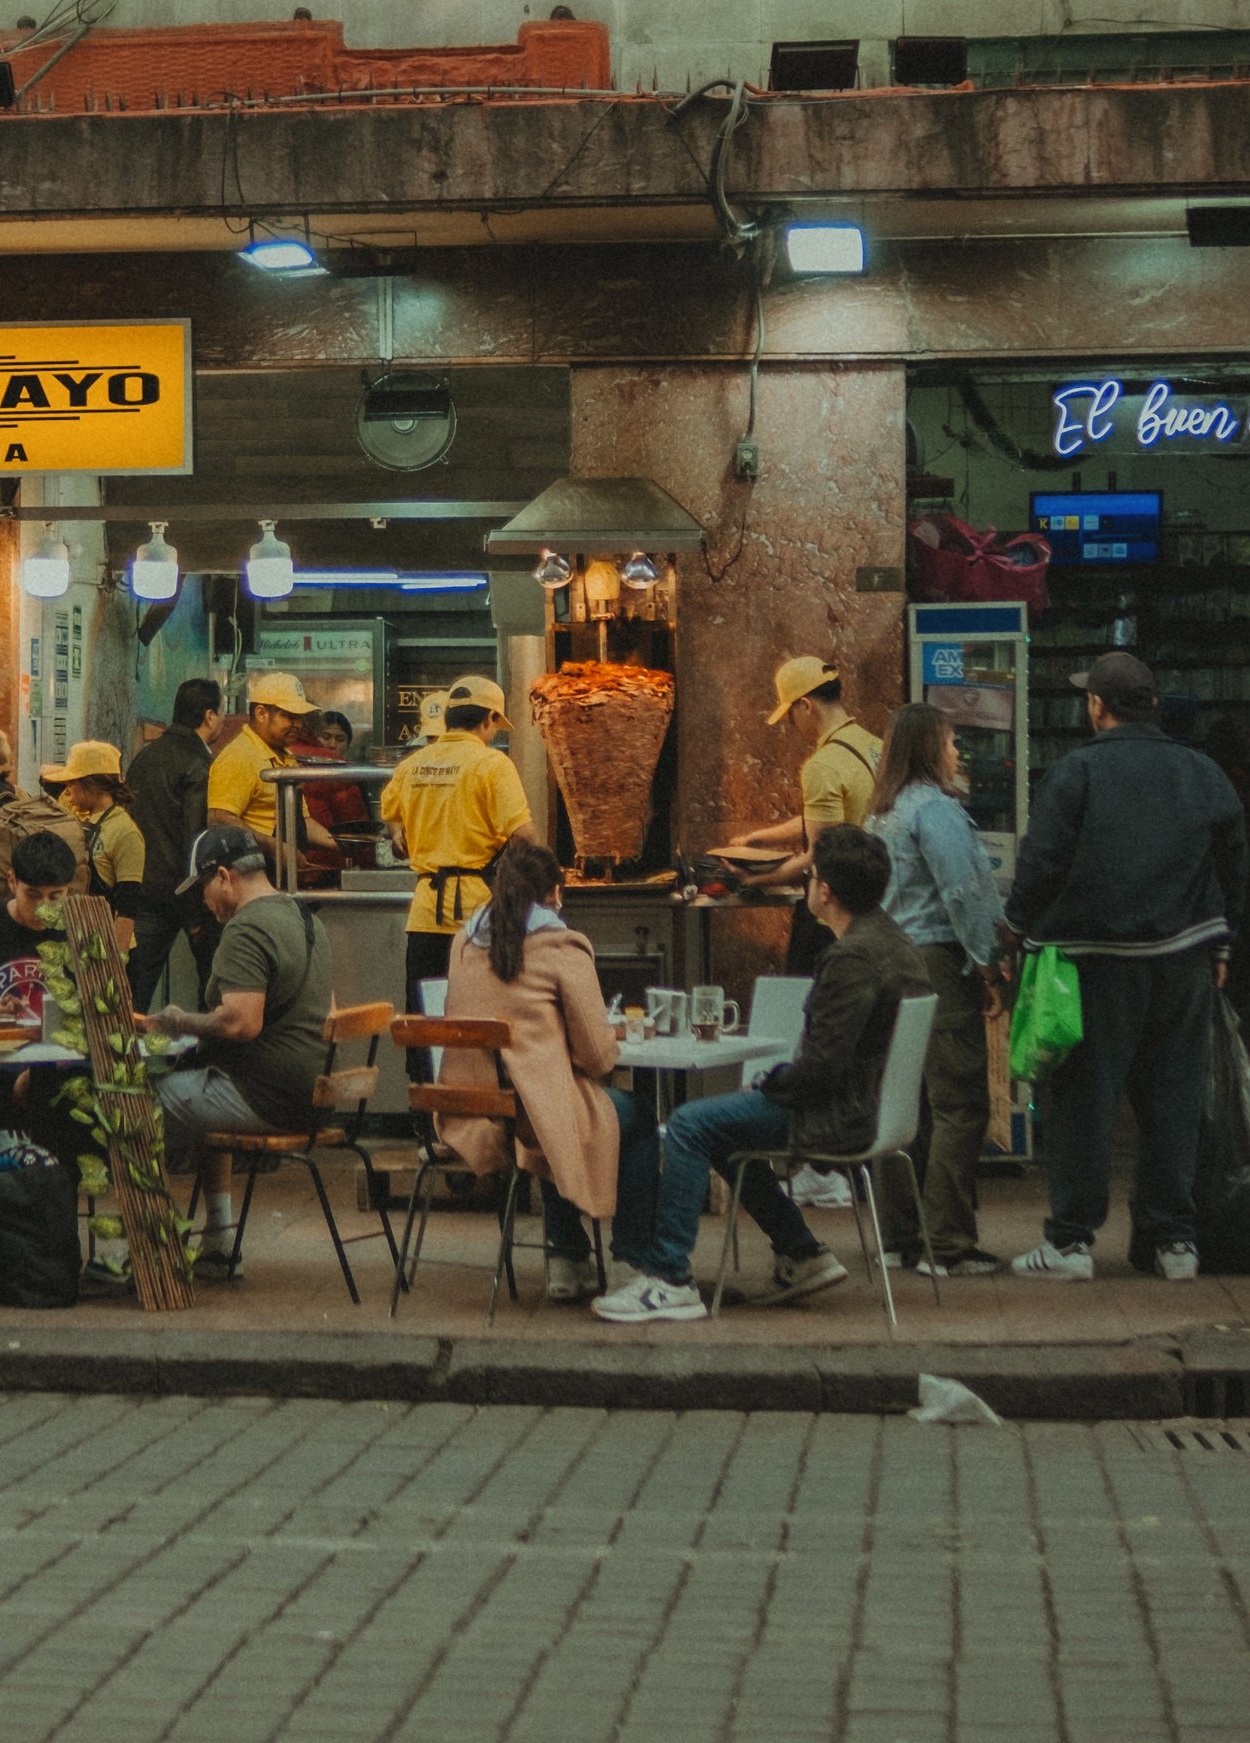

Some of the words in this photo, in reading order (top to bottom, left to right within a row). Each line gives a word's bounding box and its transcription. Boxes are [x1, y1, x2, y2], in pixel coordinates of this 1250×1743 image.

[1054, 380, 1120, 455] El
[1137, 383, 1239, 445] buen
[316, 639, 372, 650] ULTRA
